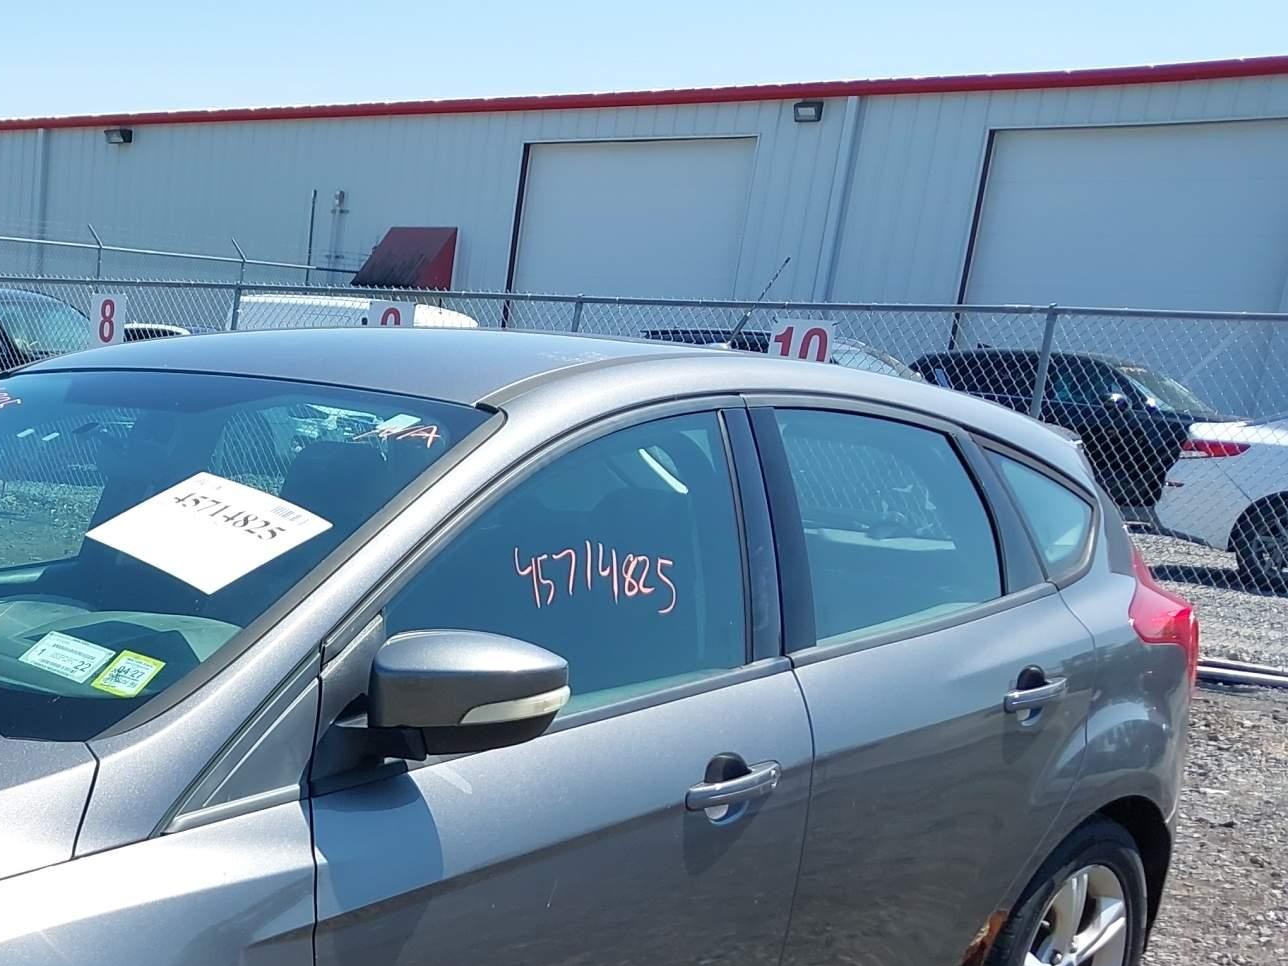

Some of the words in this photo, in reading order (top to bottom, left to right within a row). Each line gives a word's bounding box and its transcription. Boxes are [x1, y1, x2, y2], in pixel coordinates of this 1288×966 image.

[99, 299, 115, 343] 8
[774, 326, 828, 362] 10
[174, 492, 287, 541] 45714825
[515, 540, 676, 614] 45714825
[73, 660, 92, 673] 22
